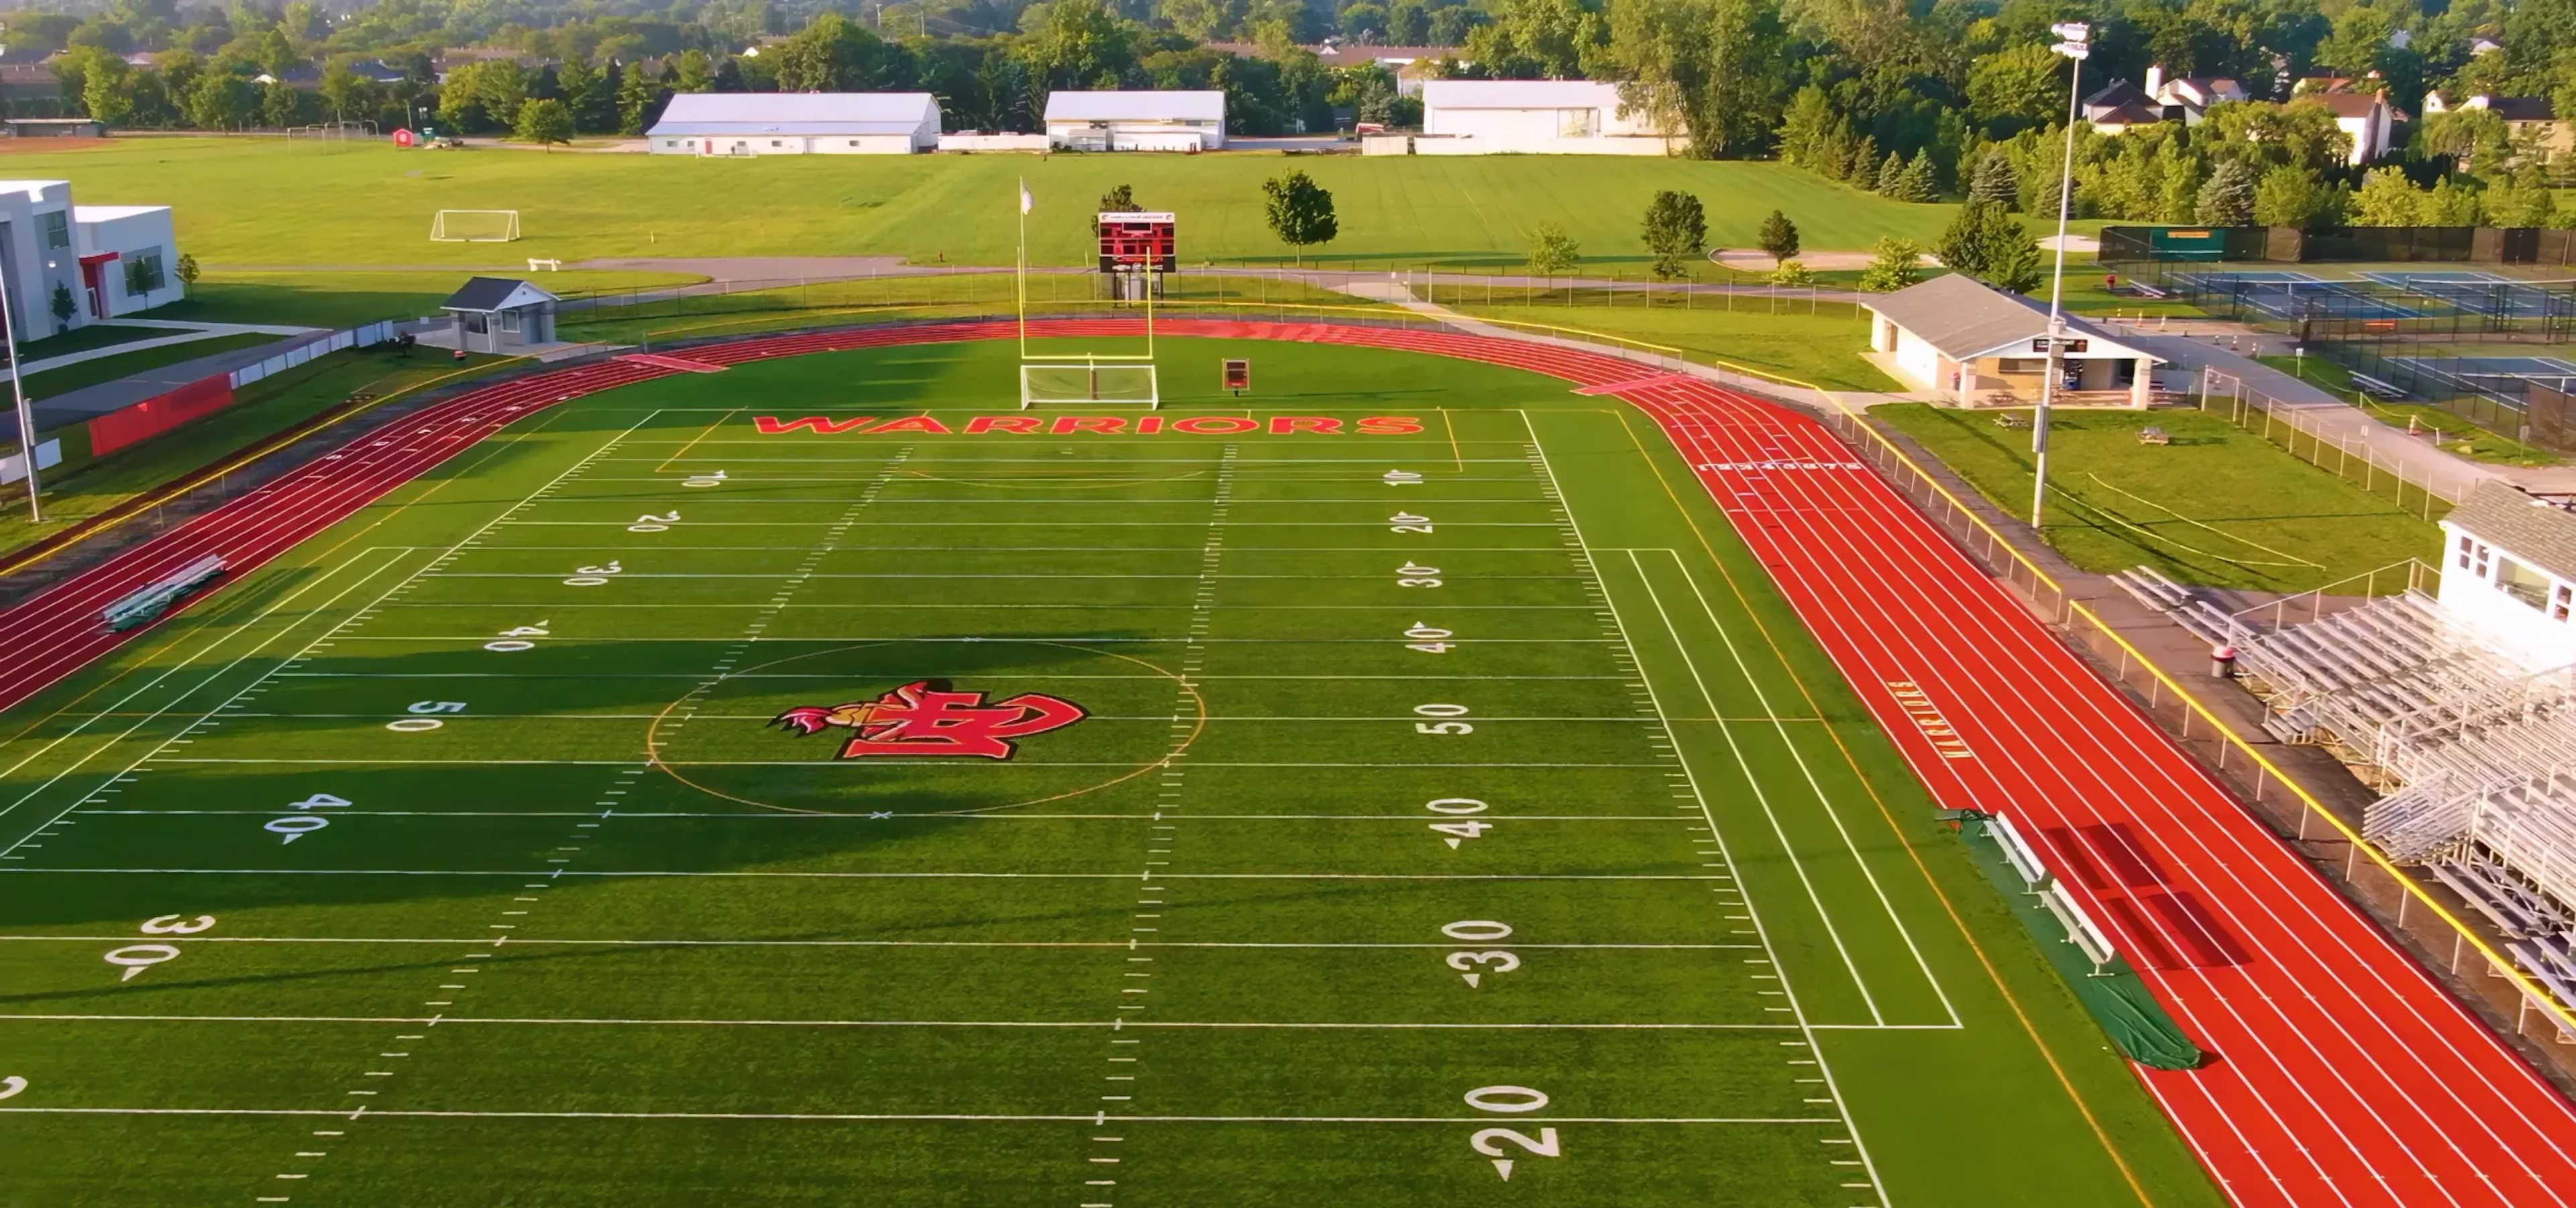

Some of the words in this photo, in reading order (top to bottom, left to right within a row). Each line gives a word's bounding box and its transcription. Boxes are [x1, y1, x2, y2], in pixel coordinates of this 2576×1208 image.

[752, 415, 1425, 435] WARRIORS
[1383, 472, 1424, 486] 10
[627, 514, 681, 532] 20
[1389, 515, 1433, 534] 20
[563, 565, 622, 585] 30
[1395, 566, 1443, 588] 30
[484, 626, 550, 652] 40
[1403, 628, 1456, 653] 40
[386, 700, 467, 732] 50
[1413, 703, 1473, 735] 50
[264, 793, 353, 833] 40
[1426, 798, 1493, 838] 40
[104, 913, 216, 966] 30
[1441, 920, 1521, 972] 30
[1464, 1085, 1560, 1157] 20
